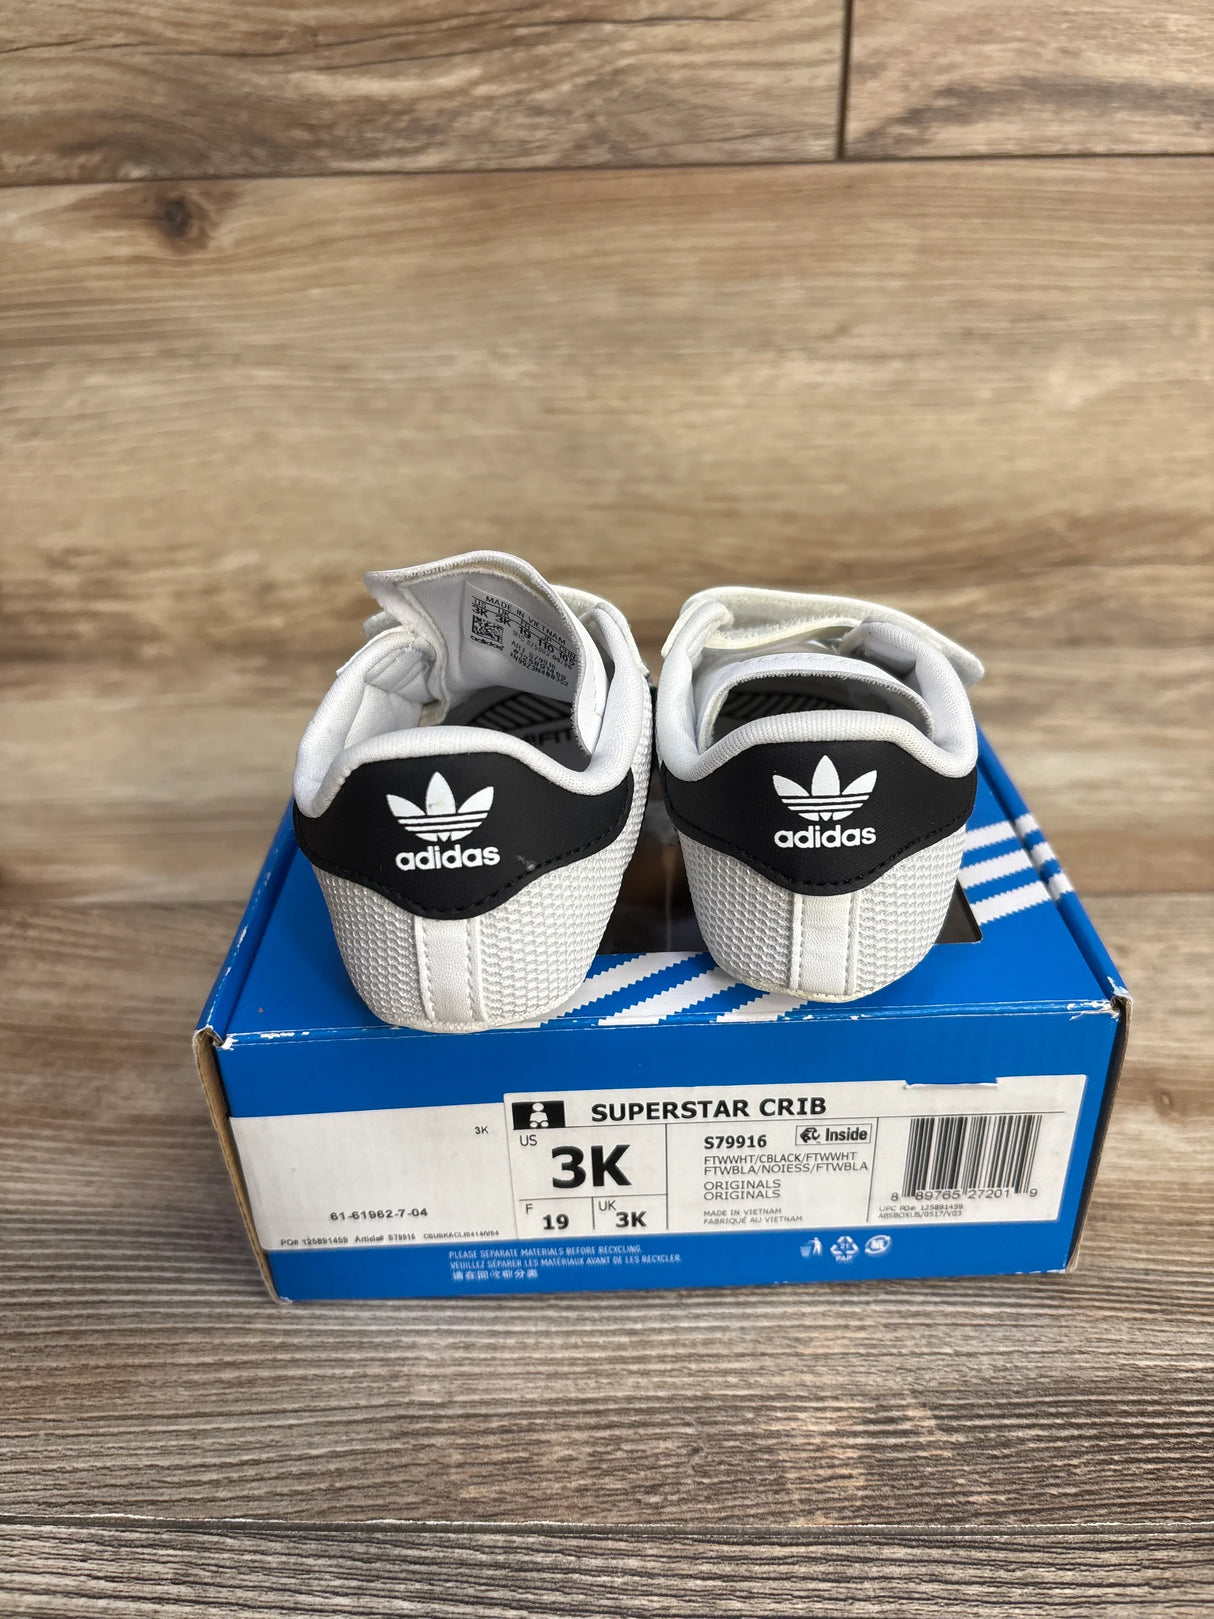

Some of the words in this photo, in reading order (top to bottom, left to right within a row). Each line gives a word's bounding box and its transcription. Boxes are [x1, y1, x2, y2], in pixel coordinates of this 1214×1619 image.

[485, 595, 512, 611] MADE
[516, 609, 525, 619] IN
[528, 616, 566, 646] VIETNAM
[519, 625, 532, 639] 19
[538, 638, 554, 653] 110
[774, 824, 877, 849] adidas
[395, 843, 501, 871] adidas
[591, 1099, 750, 1123] SUPERSTAR
[759, 1096, 827, 1117] CRIB
[474, 1126, 489, 1135] 3K
[825, 1126, 868, 1142] Inside
[519, 1134, 538, 1146] US
[704, 1134, 767, 1150] S79916
[704, 1151, 858, 1166] FTWWHT/CBLACK/FTWWHT
[551, 1144, 633, 1189] 3K
[704, 1161, 869, 1176] FTWBLA/NOIESS/FTWBLA
[704, 1179, 781, 1191] ORIGINALS
[704, 1189, 781, 1201] ORIGINALS
[891, 1191, 899, 1202] 8
[915, 1189, 960, 1201] 89765
[967, 1188, 1010, 1200] 27201
[1029, 1188, 1038, 1198] 9
[525, 1203, 534, 1214] F
[598, 1200, 617, 1212] UK
[704, 1209, 727, 1217] MADE
[730, 1208, 740, 1216] IN
[744, 1207, 782, 1215] VIETNAM
[329, 1207, 429, 1222] 61-61962-7-04
[543, 1213, 570, 1230] 19
[615, 1211, 647, 1229] 3K
[703, 1216, 746, 1225] FABRIQUÉ
[764, 1215, 803, 1223] VIETNAM
[449, 1250, 478, 1259] PLEASE
[480, 1248, 518, 1258] SEPARATE
[521, 1247, 564, 1257] MATERIALS
[566, 1246, 596, 1255] BEFORE
[835, 1255, 853, 1263] PAP
[450, 1260, 485, 1269] VEUILLEZ
[524, 1258, 539, 1267] LES
[585, 1255, 611, 1265] AVANT
[613, 1255, 623, 1264] DE
[625, 1254, 640, 1264] LES
